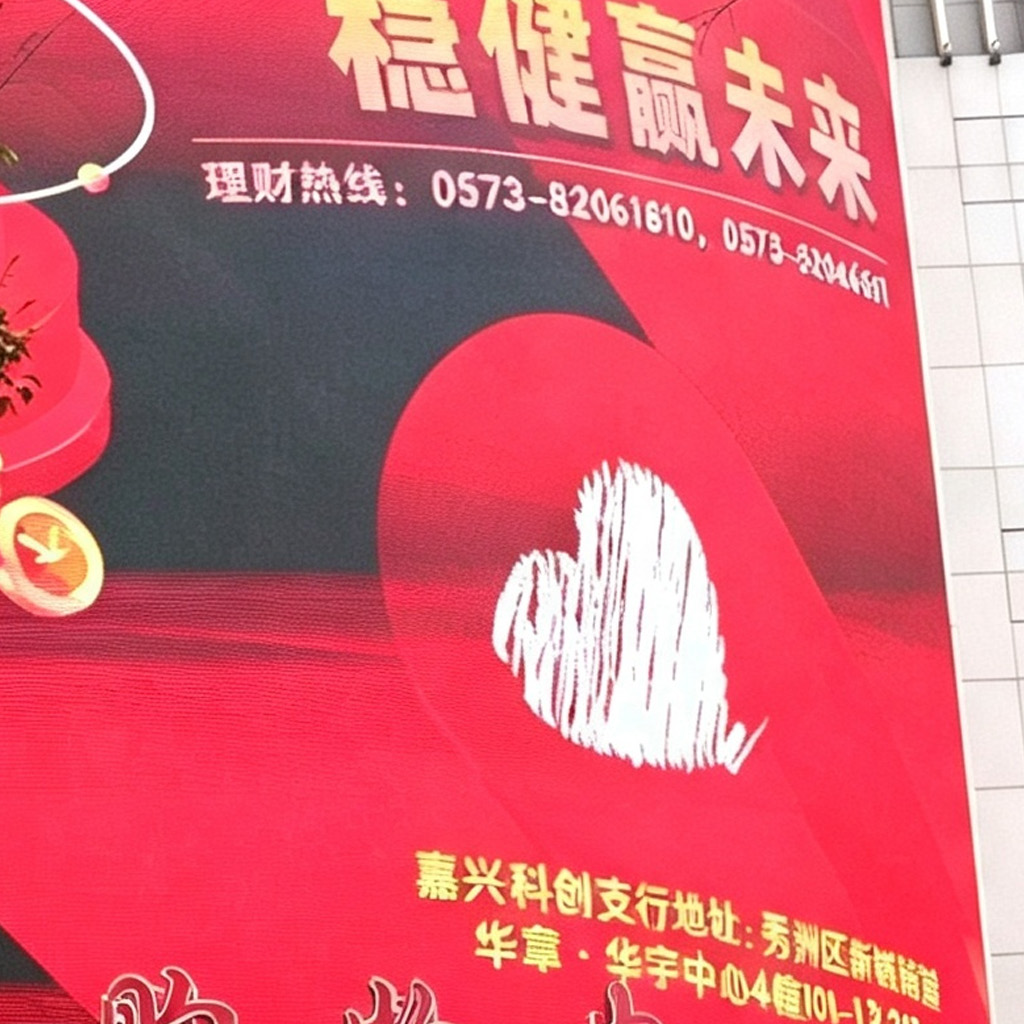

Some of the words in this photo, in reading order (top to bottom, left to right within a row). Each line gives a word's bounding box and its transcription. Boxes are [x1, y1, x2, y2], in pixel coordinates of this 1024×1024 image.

[328, 0, 878, 224] 稳健赢未来
